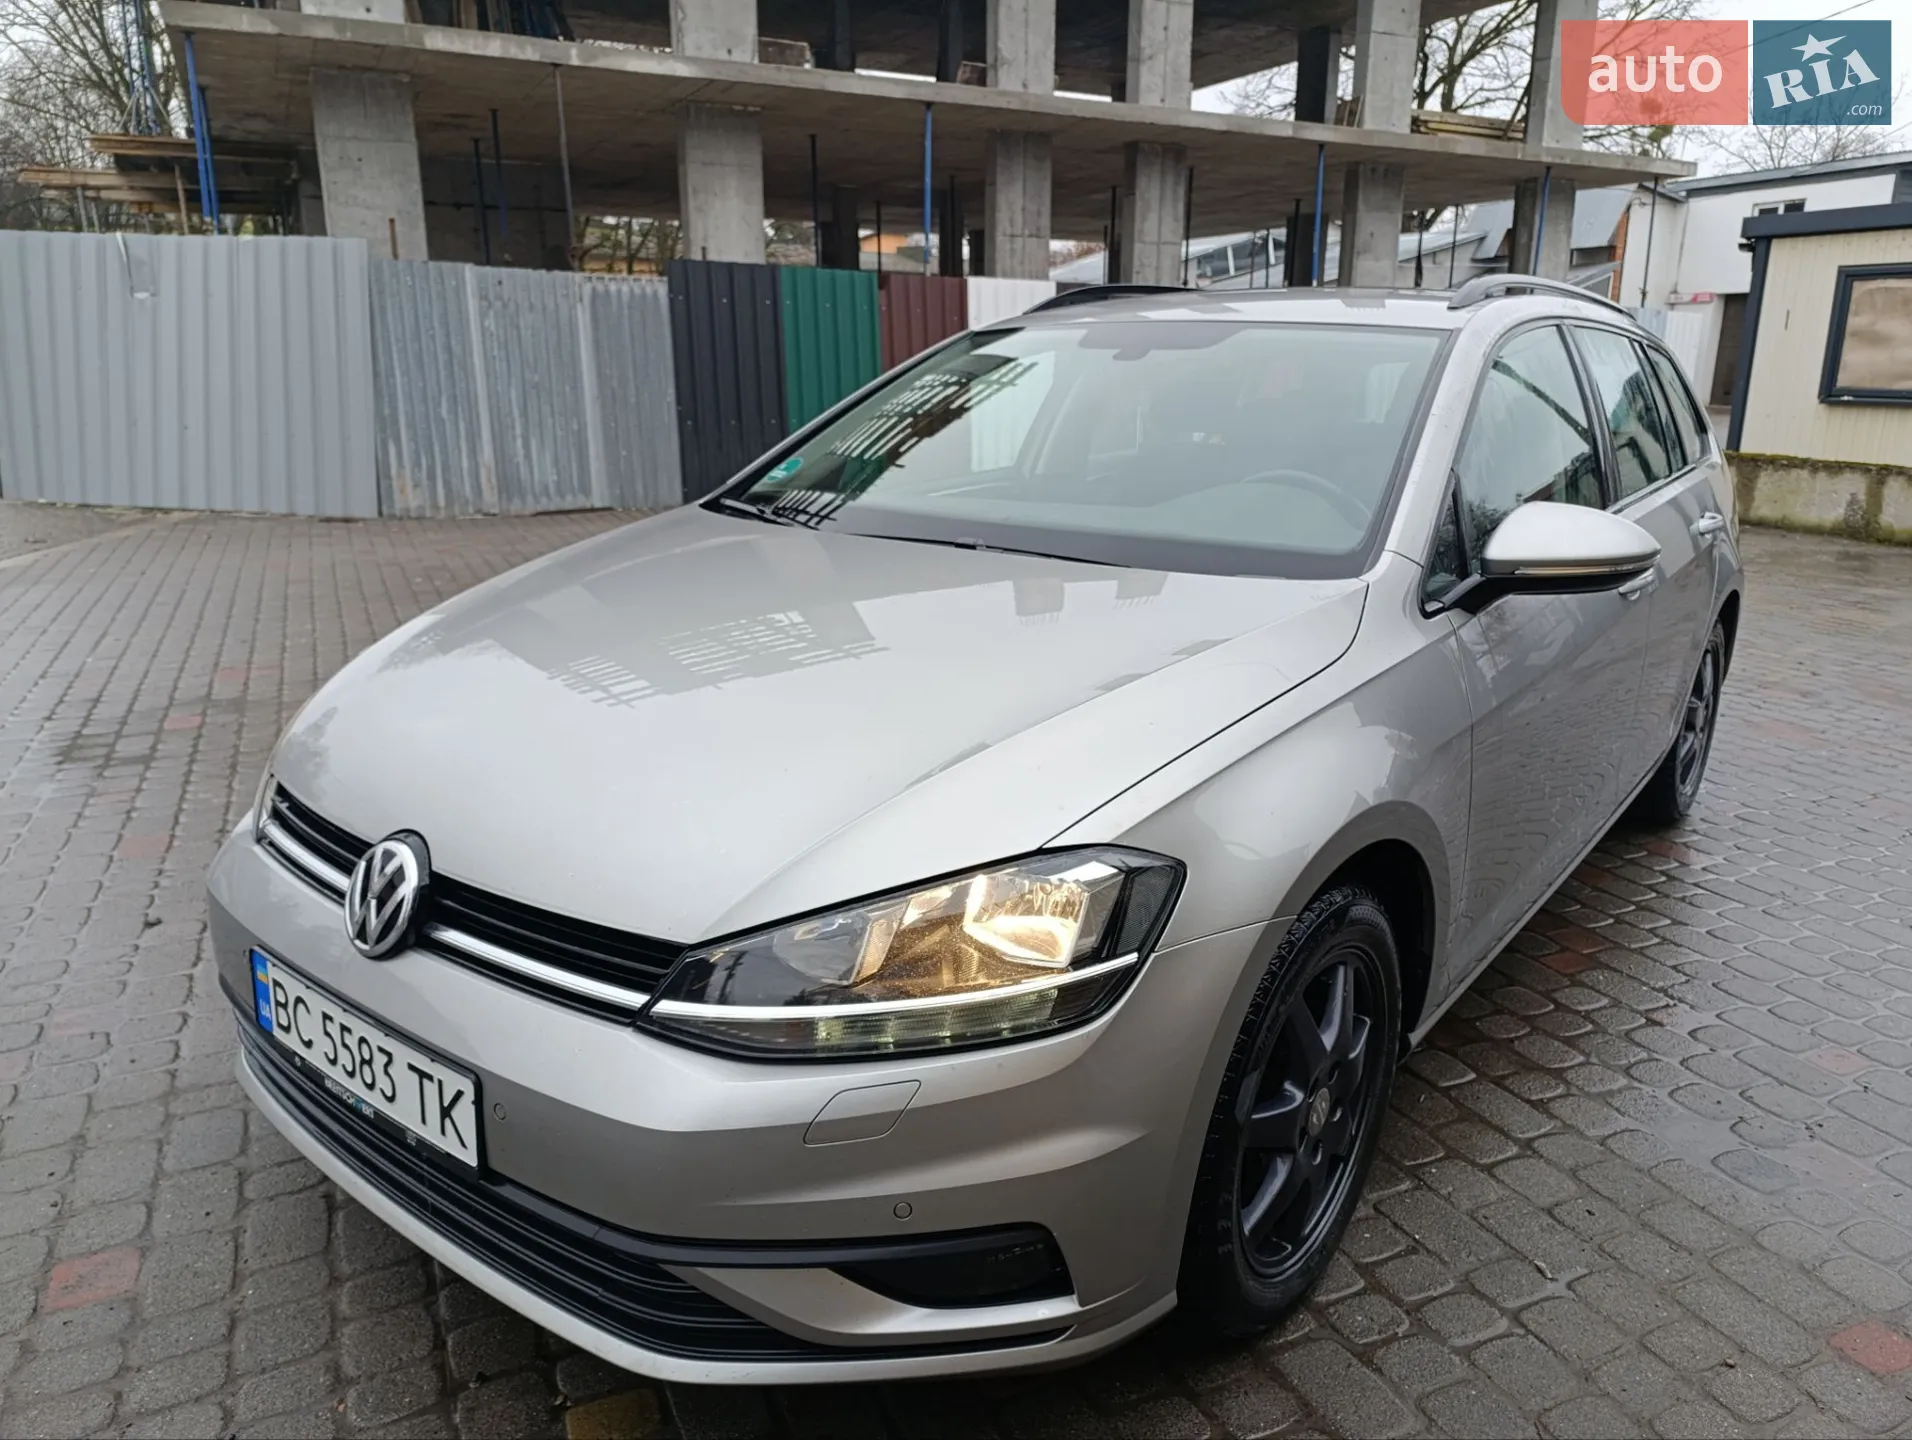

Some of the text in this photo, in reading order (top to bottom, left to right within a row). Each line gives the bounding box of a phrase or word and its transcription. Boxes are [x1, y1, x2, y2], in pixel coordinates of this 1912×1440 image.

[259, 998, 272, 1021] UA
[271, 977, 313, 1050] BC
[321, 1008, 396, 1104] 5583
[406, 1061, 468, 1150] TK
